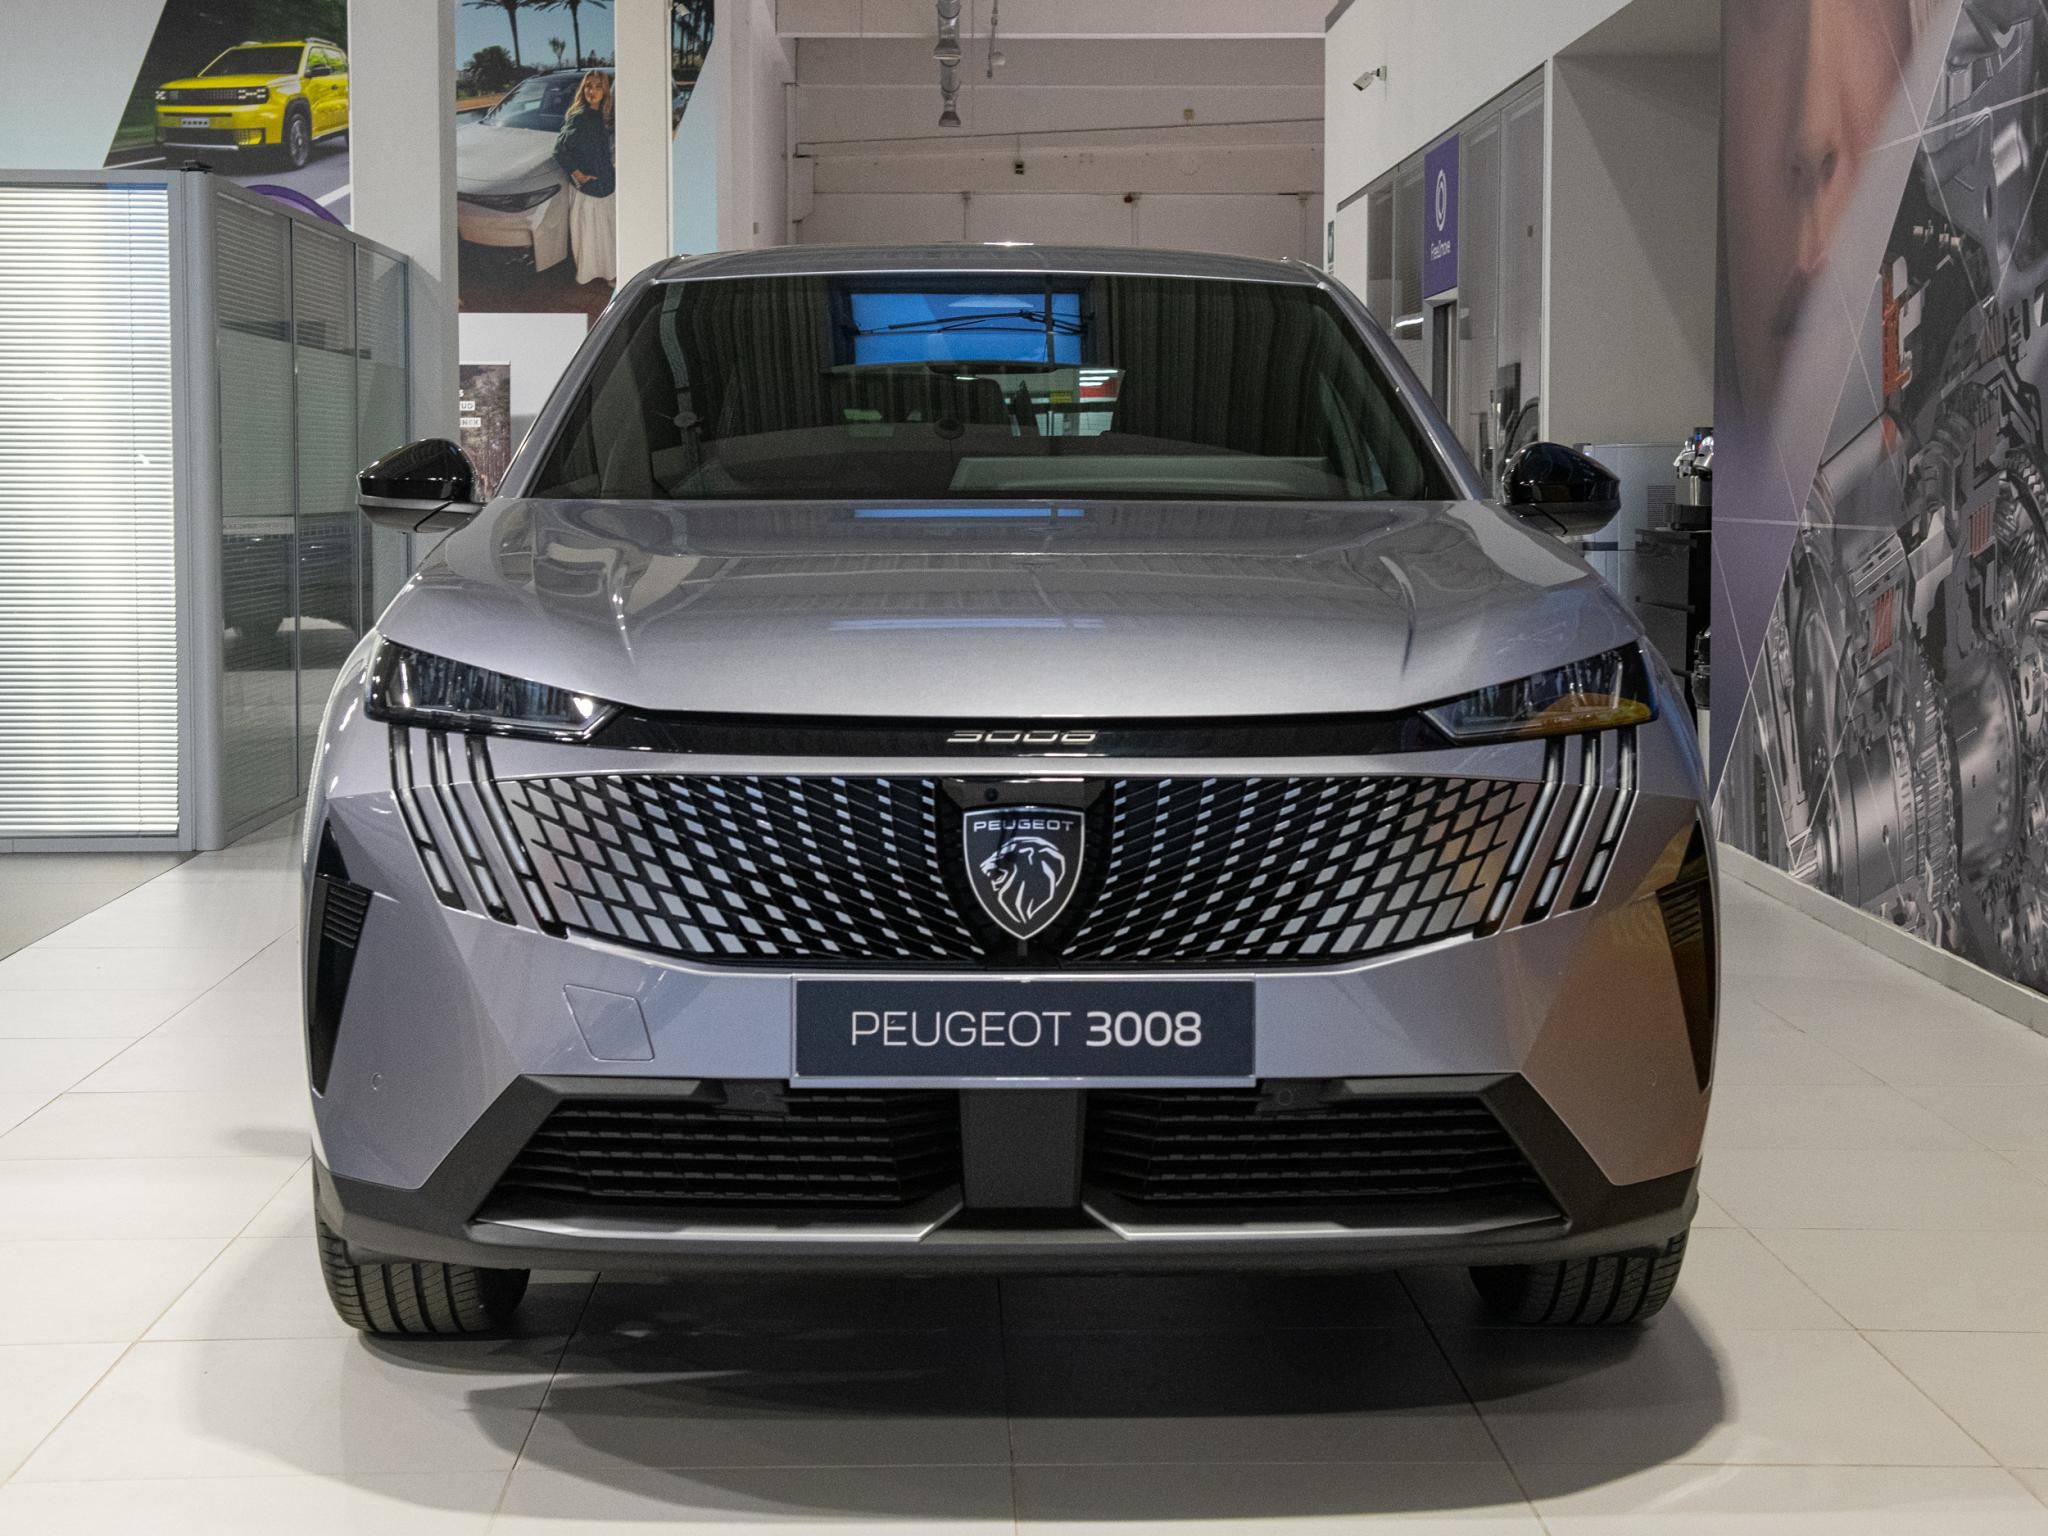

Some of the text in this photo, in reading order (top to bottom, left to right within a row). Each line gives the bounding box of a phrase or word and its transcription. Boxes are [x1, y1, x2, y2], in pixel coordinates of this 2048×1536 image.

[973, 818, 1075, 832] PEUGEOT
[851, 1011, 1202, 1047] PEUGEOT 3008
